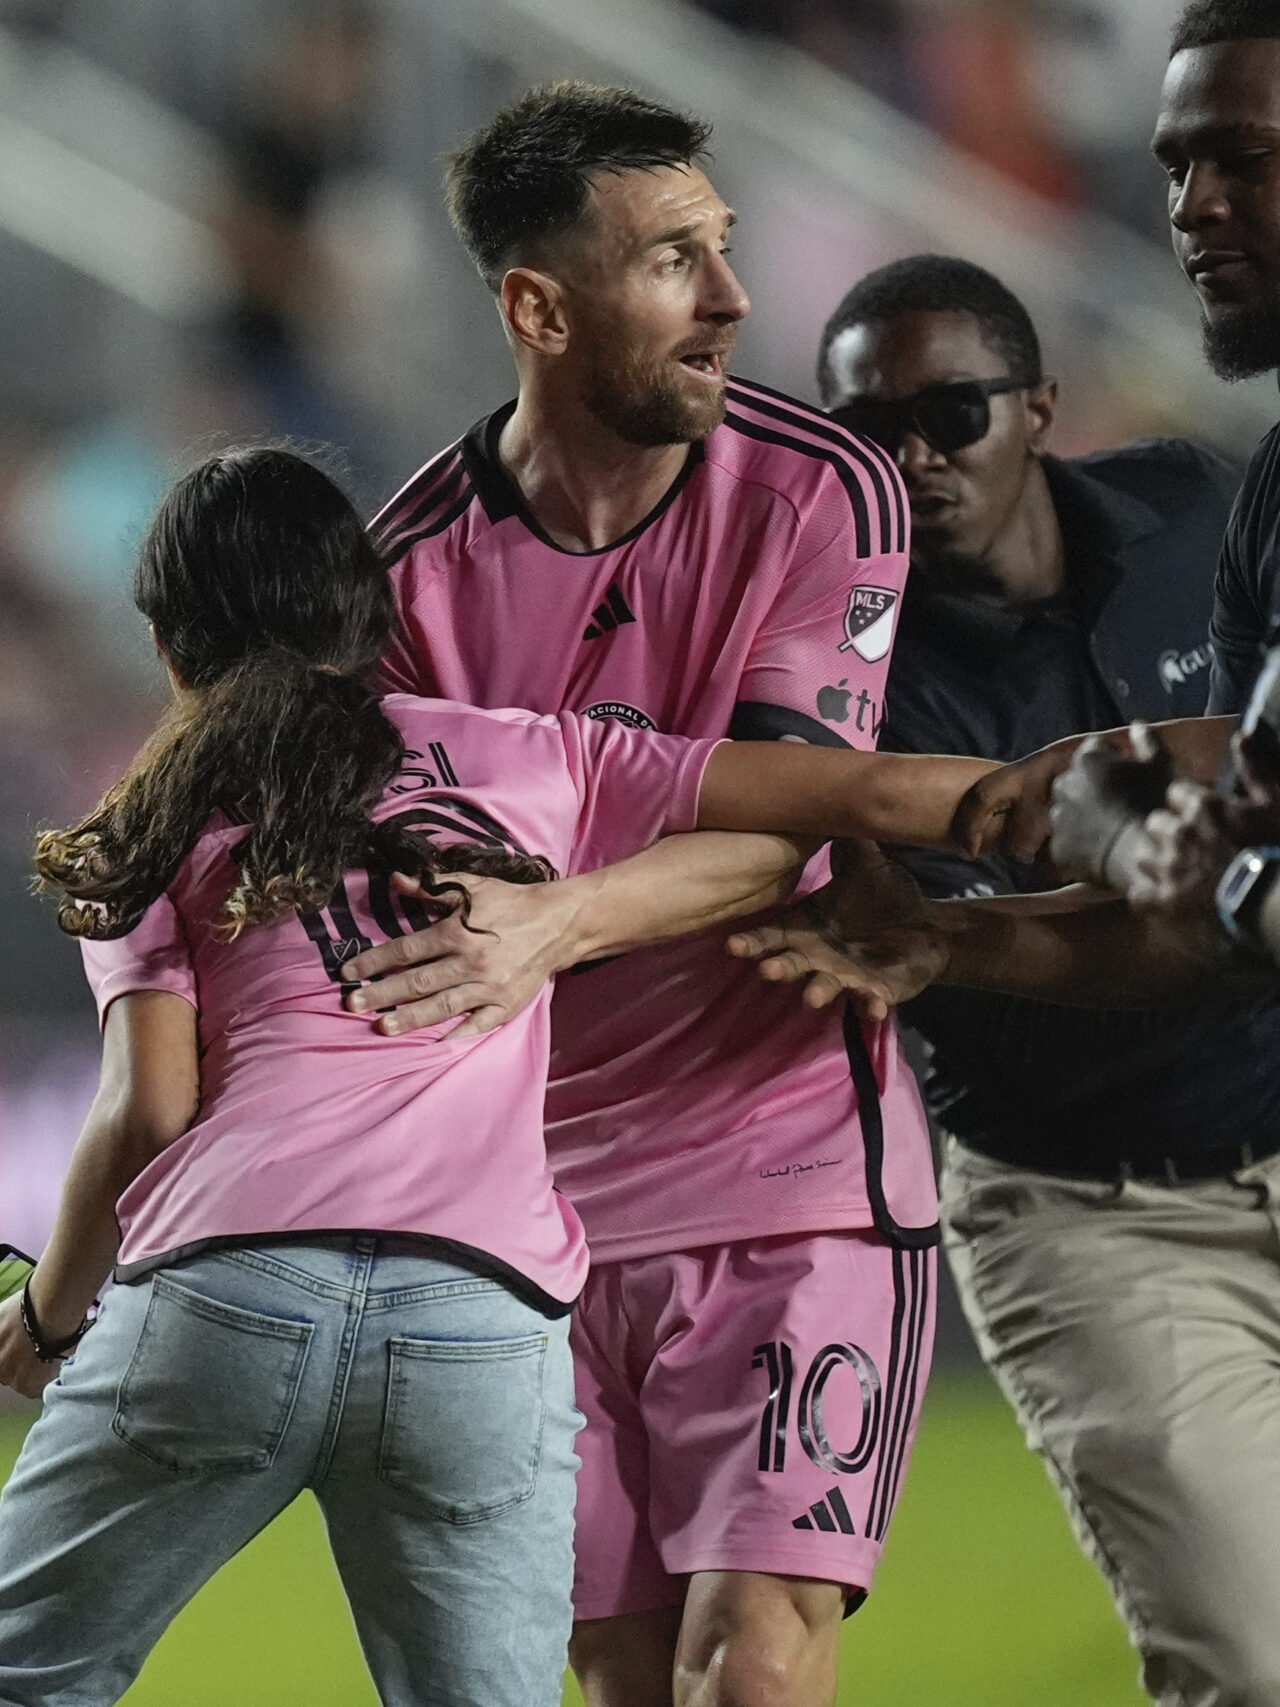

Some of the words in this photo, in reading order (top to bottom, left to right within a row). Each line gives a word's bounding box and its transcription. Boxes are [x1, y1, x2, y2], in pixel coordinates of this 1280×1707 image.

[855, 591, 886, 611] MLS
[856, 688, 883, 739] tv
[388, 741, 460, 795] SI
[751, 1341, 882, 1476] 10
